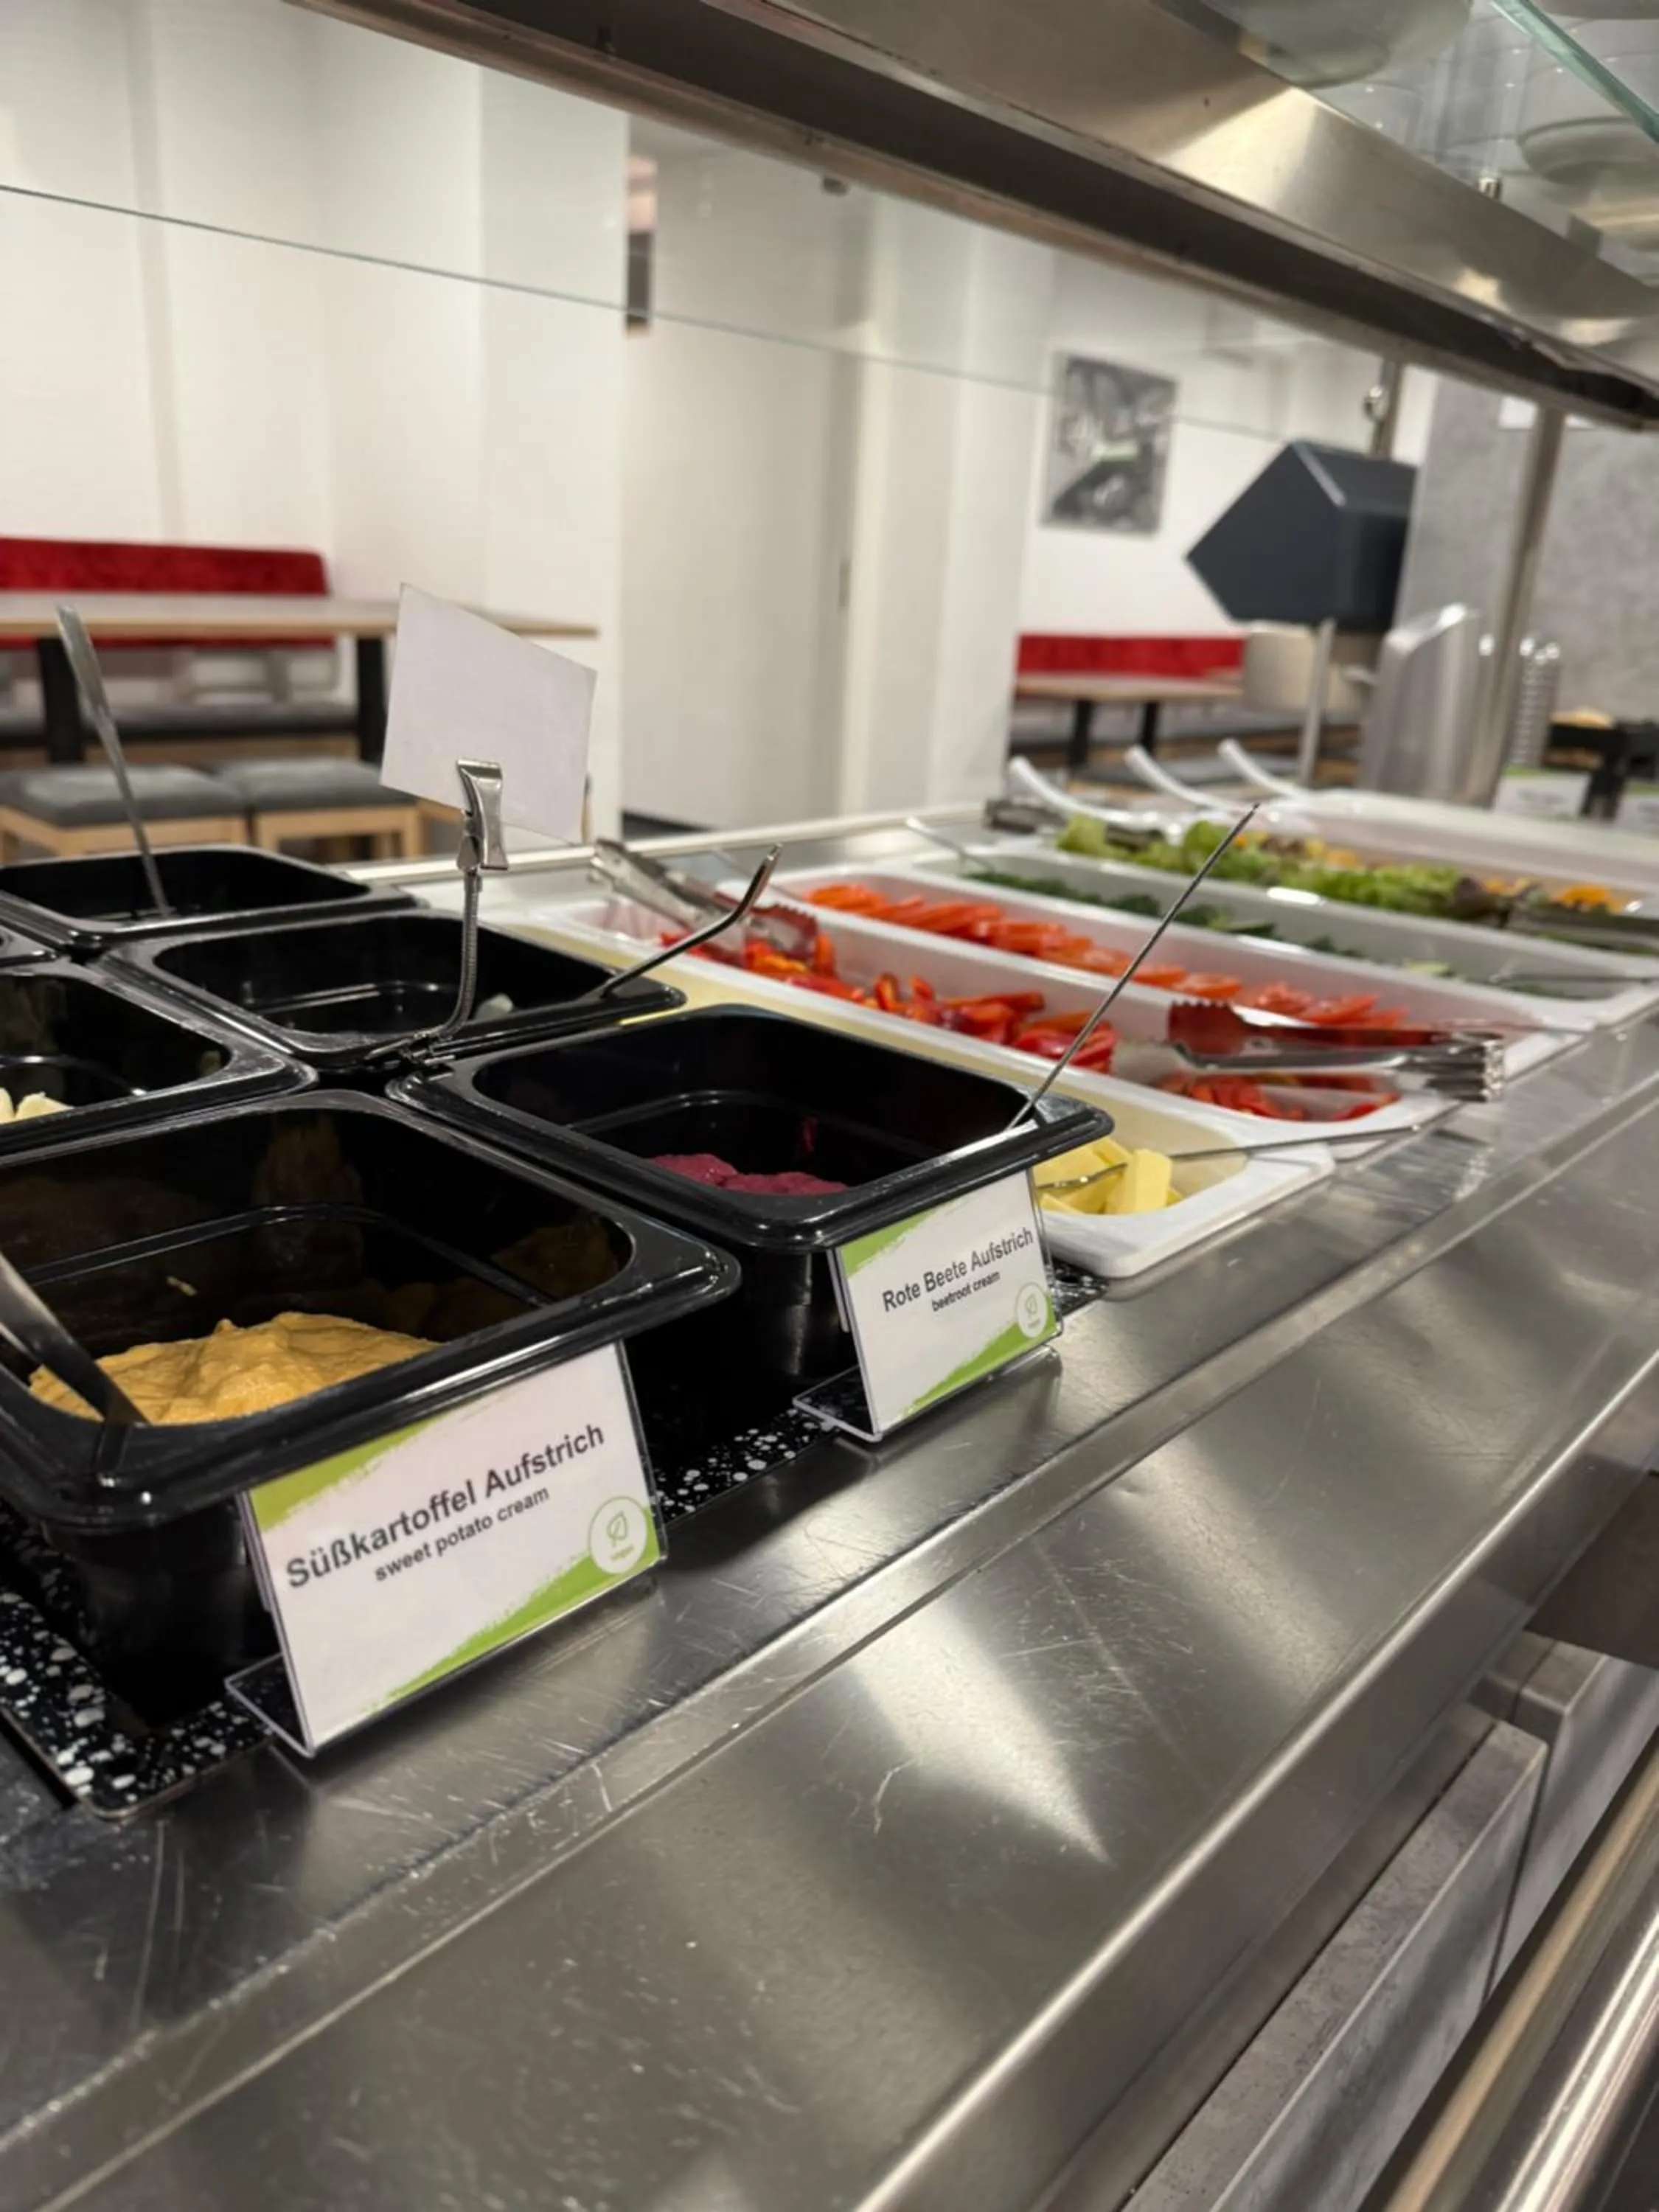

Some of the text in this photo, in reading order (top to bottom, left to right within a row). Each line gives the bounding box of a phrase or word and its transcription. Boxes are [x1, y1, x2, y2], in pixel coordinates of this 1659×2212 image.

[883, 1227, 1033, 1312] Rote Beete Aufstrich
[932, 1271, 1000, 1311] beetroot cream
[286, 1424, 605, 1587] Süßkartoffel Aufstrich
[375, 1486, 549, 1582] sweet potato cream
